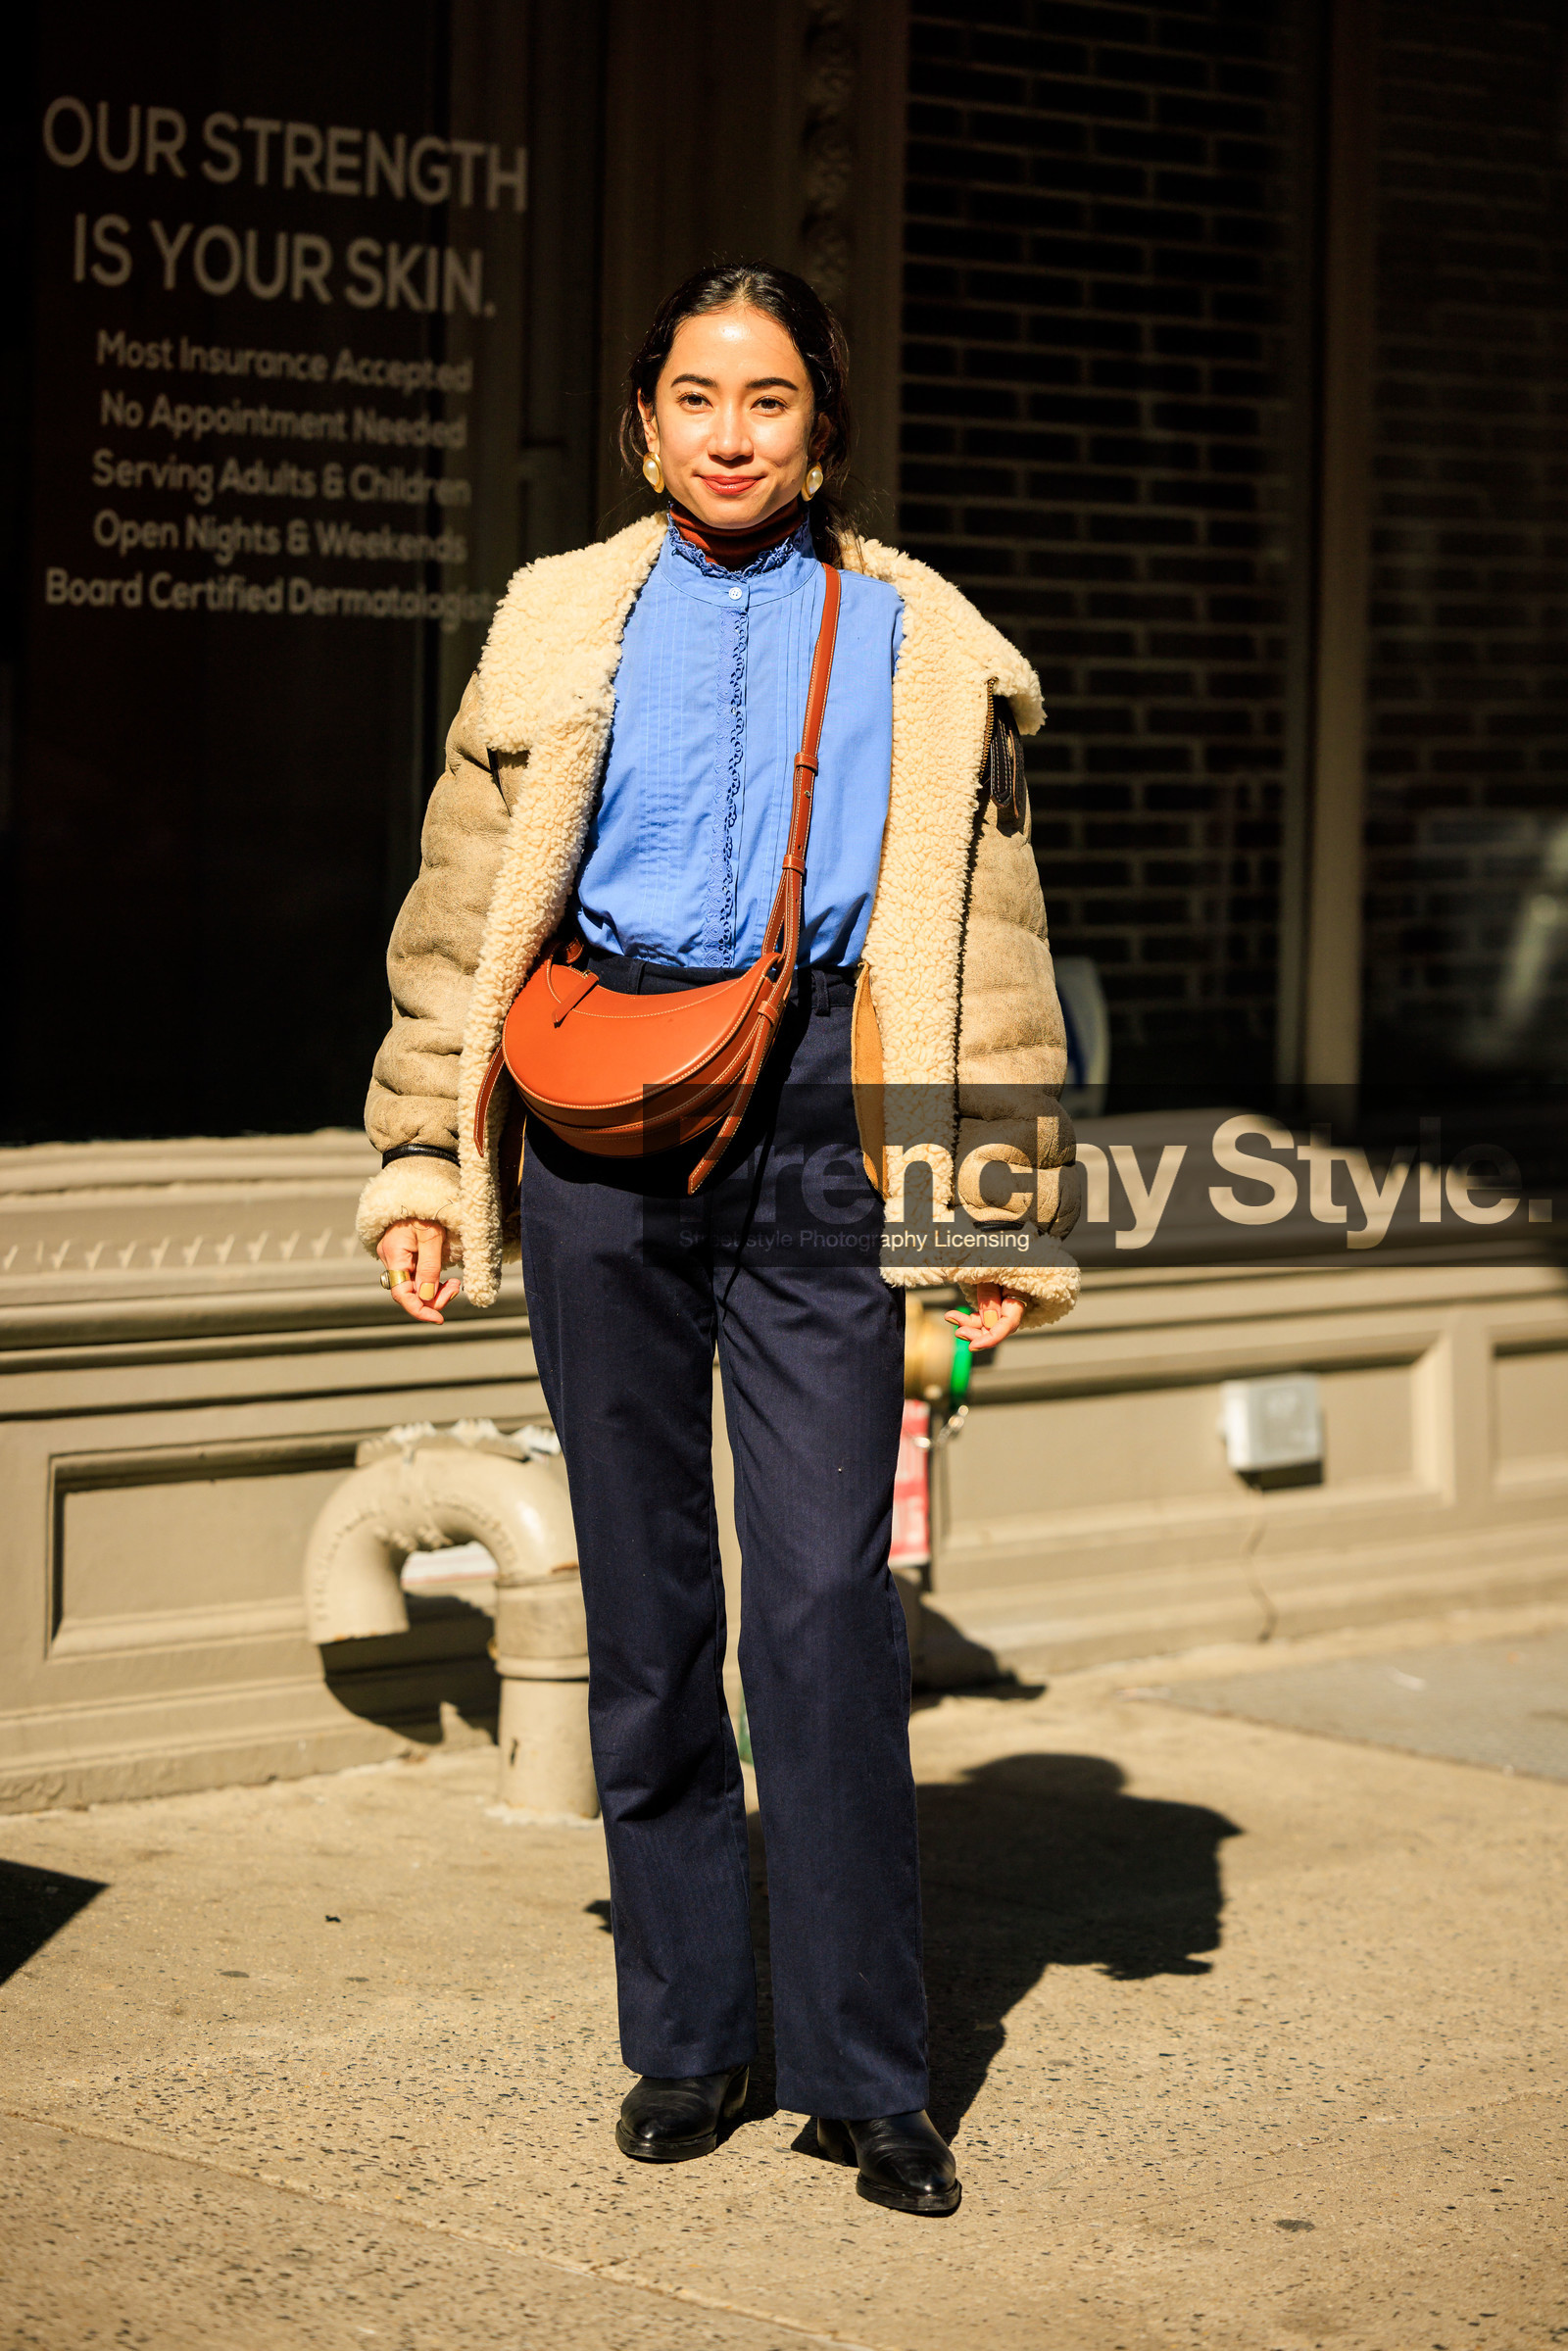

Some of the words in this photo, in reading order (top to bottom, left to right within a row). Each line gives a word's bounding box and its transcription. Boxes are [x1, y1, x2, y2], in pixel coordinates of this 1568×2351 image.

[42, 96, 187, 178] OUR
[201, 112, 528, 213] STRENGTH
[74, 212, 133, 287] IS
[149, 219, 332, 305] YOUR
[344, 237, 497, 318] SKIN.
[97, 329, 174, 370] Most
[179, 336, 329, 383] Insurance
[332, 348, 474, 397] Accepted
[100, 390, 144, 427] No
[148, 394, 348, 441] Appointment
[352, 408, 468, 450] Needed
[92, 448, 214, 505] Serving
[218, 457, 317, 499] Adults
[321, 462, 345, 500] &
[349, 464, 472, 507] Children
[93, 510, 178, 557] Open
[184, 514, 281, 565] Nights
[286, 518, 310, 556] &
[315, 519, 468, 564] Weekends
[45, 565, 143, 608] Board
[149, 571, 284, 612] Certified
